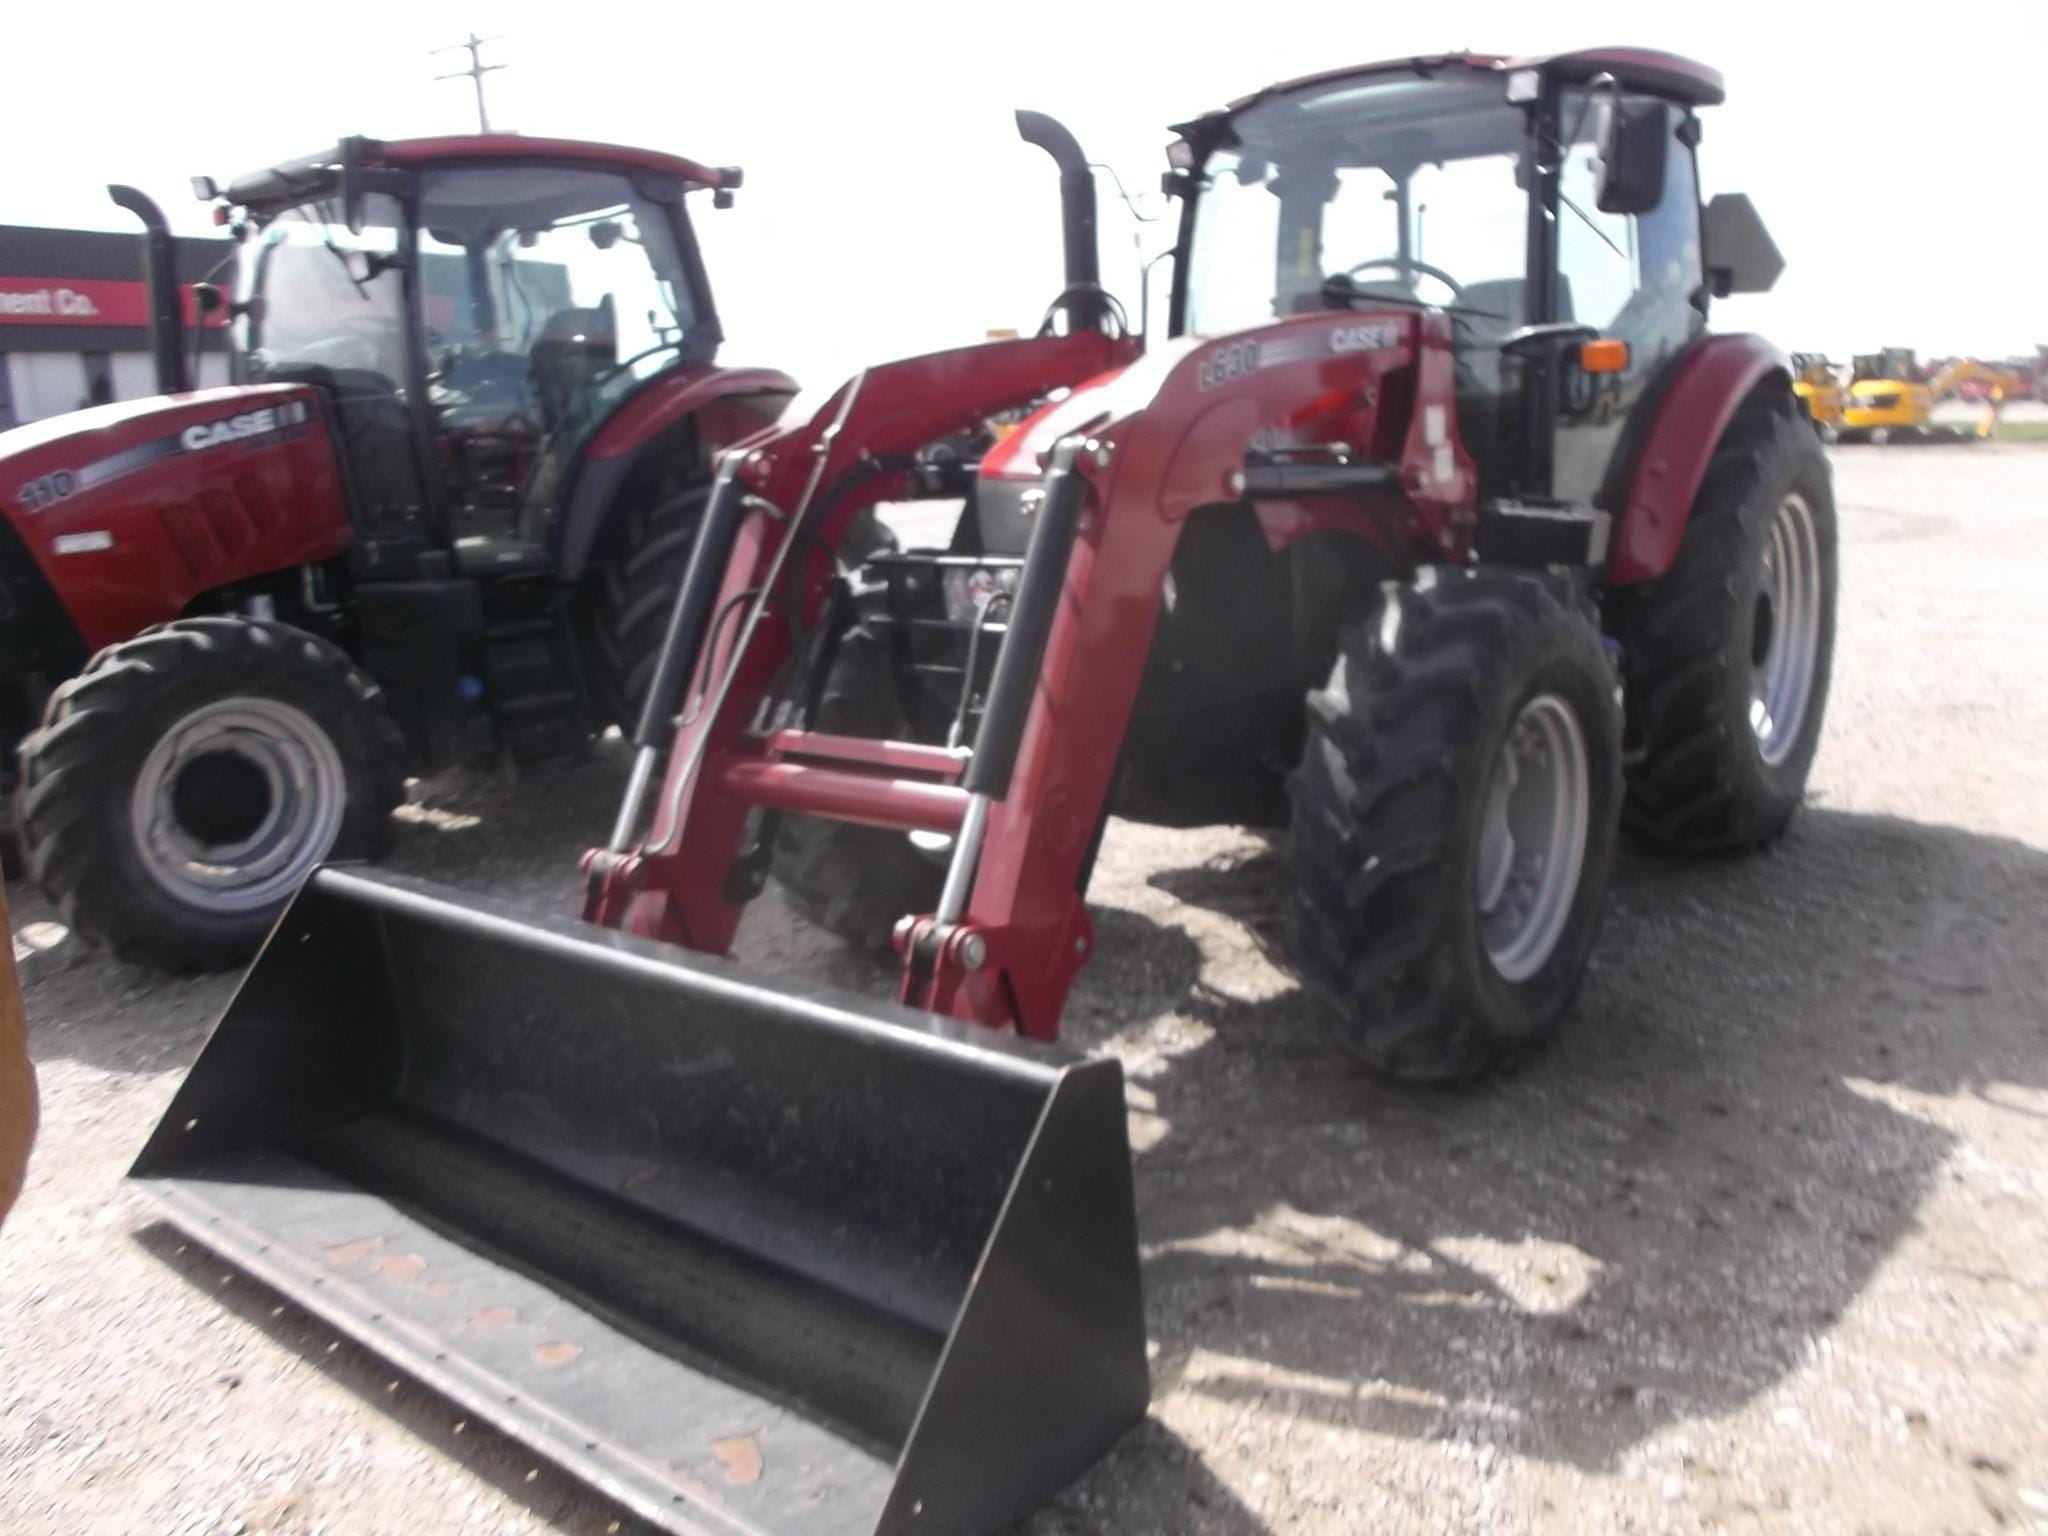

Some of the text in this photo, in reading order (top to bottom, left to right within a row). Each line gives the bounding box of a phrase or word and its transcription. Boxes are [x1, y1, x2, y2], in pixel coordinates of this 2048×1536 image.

[55, 288, 99, 315] Co.
[1331, 327, 1381, 352] CASE
[182, 408, 276, 450] CASE
